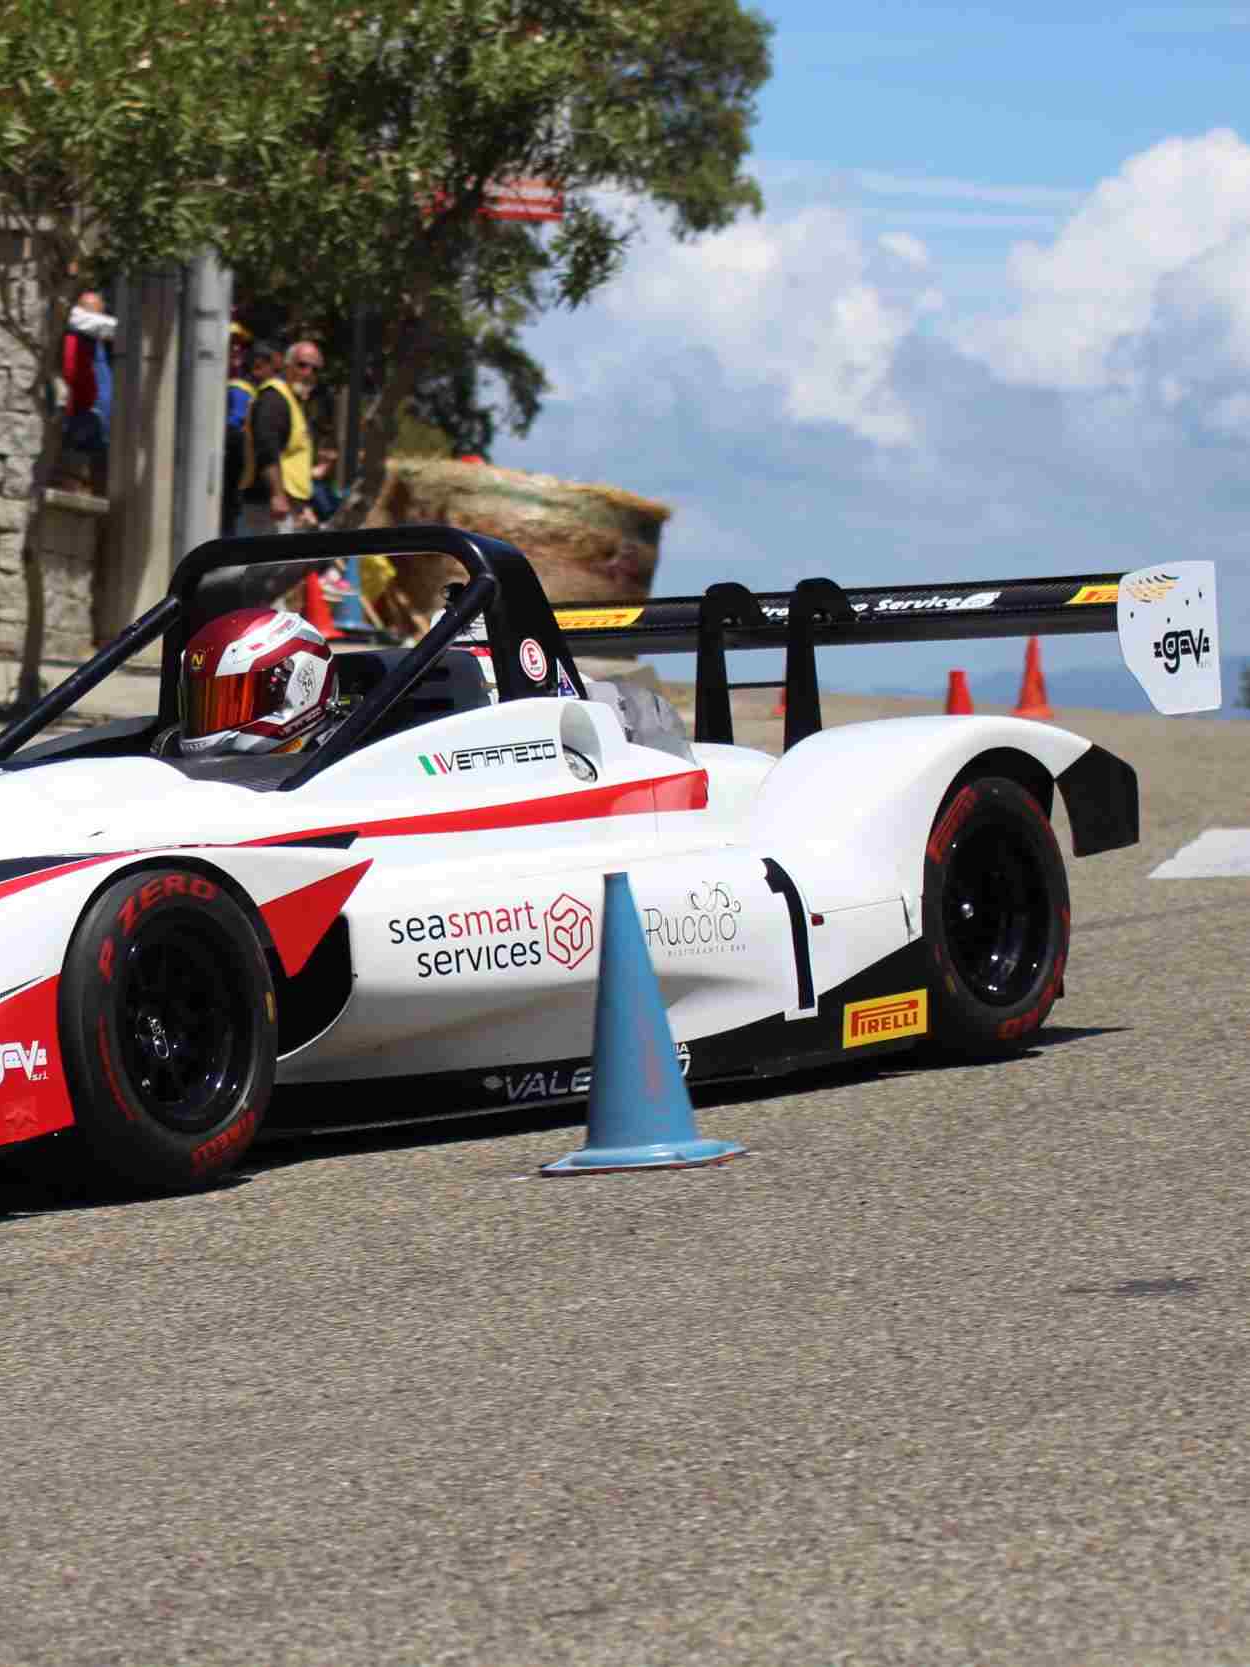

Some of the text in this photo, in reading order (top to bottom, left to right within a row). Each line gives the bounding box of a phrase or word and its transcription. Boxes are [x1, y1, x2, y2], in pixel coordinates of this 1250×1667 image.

[116, 873, 219, 937] ZERO
[389, 900, 538, 944] seasmart
[417, 939, 542, 978] services
[850, 999, 919, 1038] PIRELLI
[505, 1067, 594, 1099] VALE
